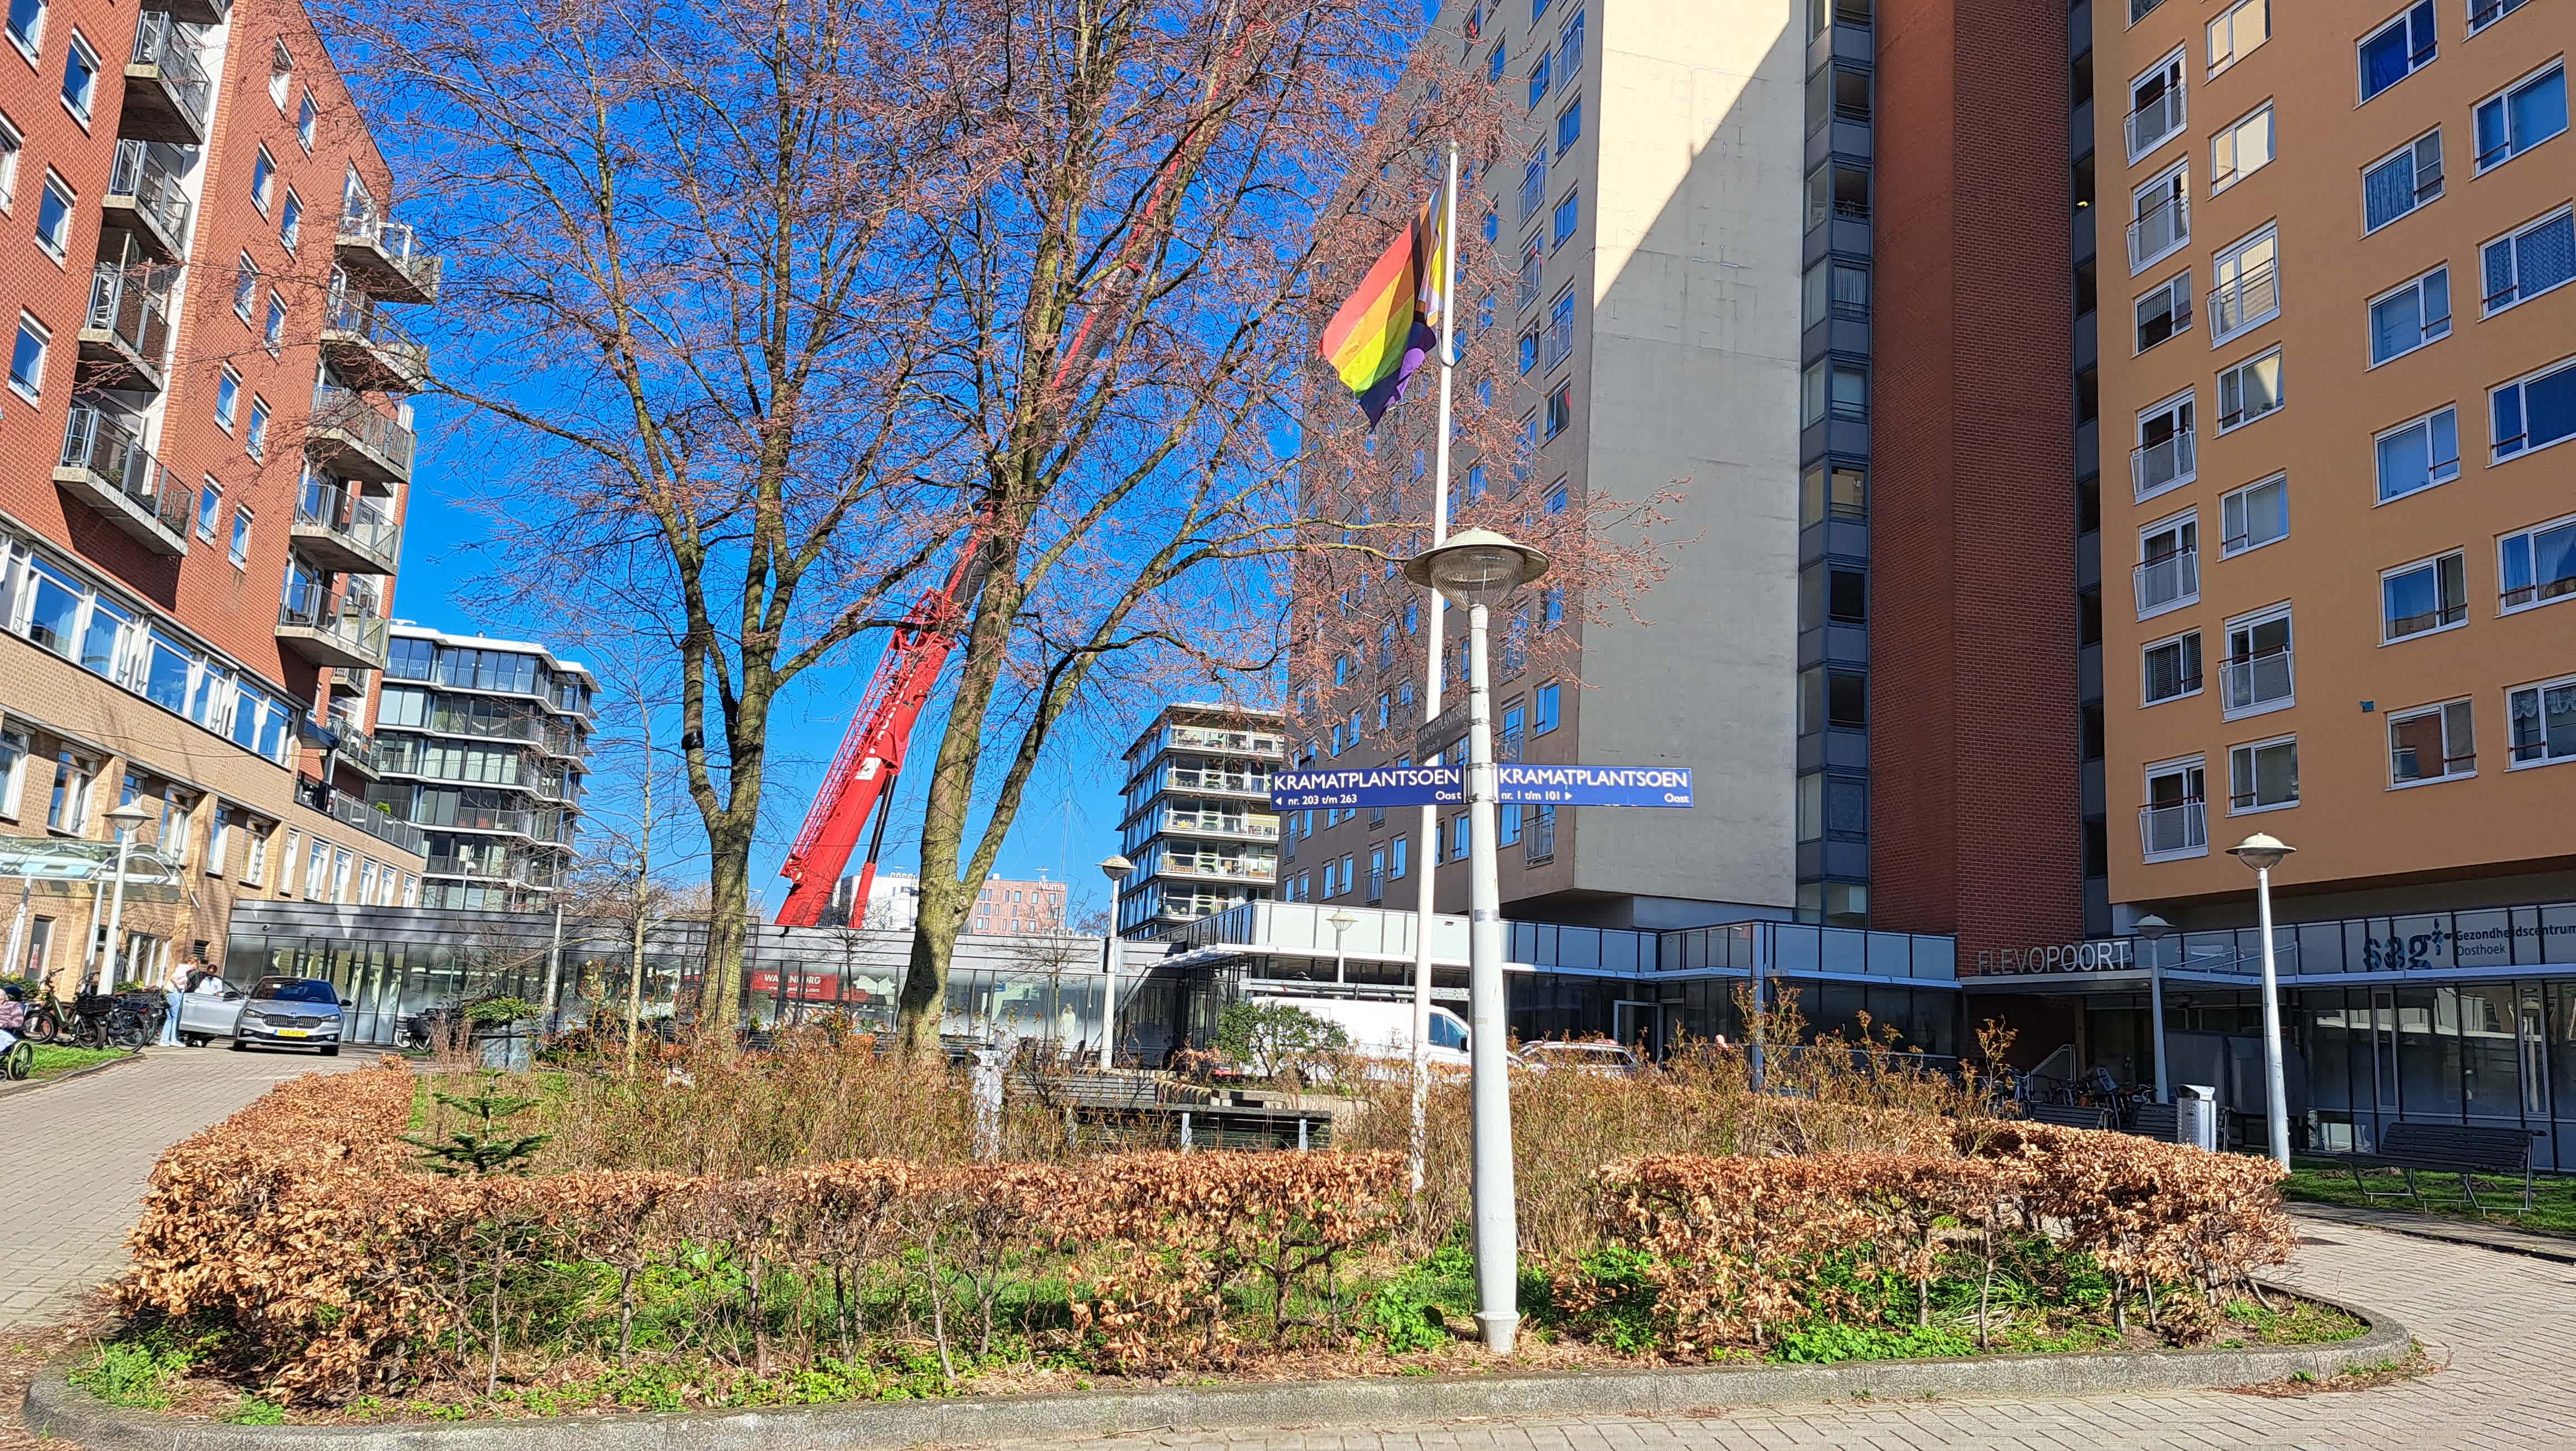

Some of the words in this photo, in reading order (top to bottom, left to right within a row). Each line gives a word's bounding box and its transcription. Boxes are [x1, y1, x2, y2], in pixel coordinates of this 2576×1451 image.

[1274, 768, 1460, 791] KRAMATPLANTSOEN
[1499, 768, 1688, 787] KRAMATPLANTSOEN
[1302, 796, 1319, 805] 203
[1322, 795, 1338, 804] t/m
[1340, 794, 1357, 804] 263
[1435, 791, 1462, 801] Oost
[1501, 791, 1514, 800] nr.
[1517, 790, 1521, 800] 1
[1524, 791, 1541, 800] t/m
[1545, 791, 1560, 801] 101
[1664, 793, 1690, 804] Oost
[2456, 924, 2576, 941] Gezondhedscentrum
[2456, 943, 2506, 956] Oosthoek
[1978, 941, 2129, 975] FLEVOPOORT
